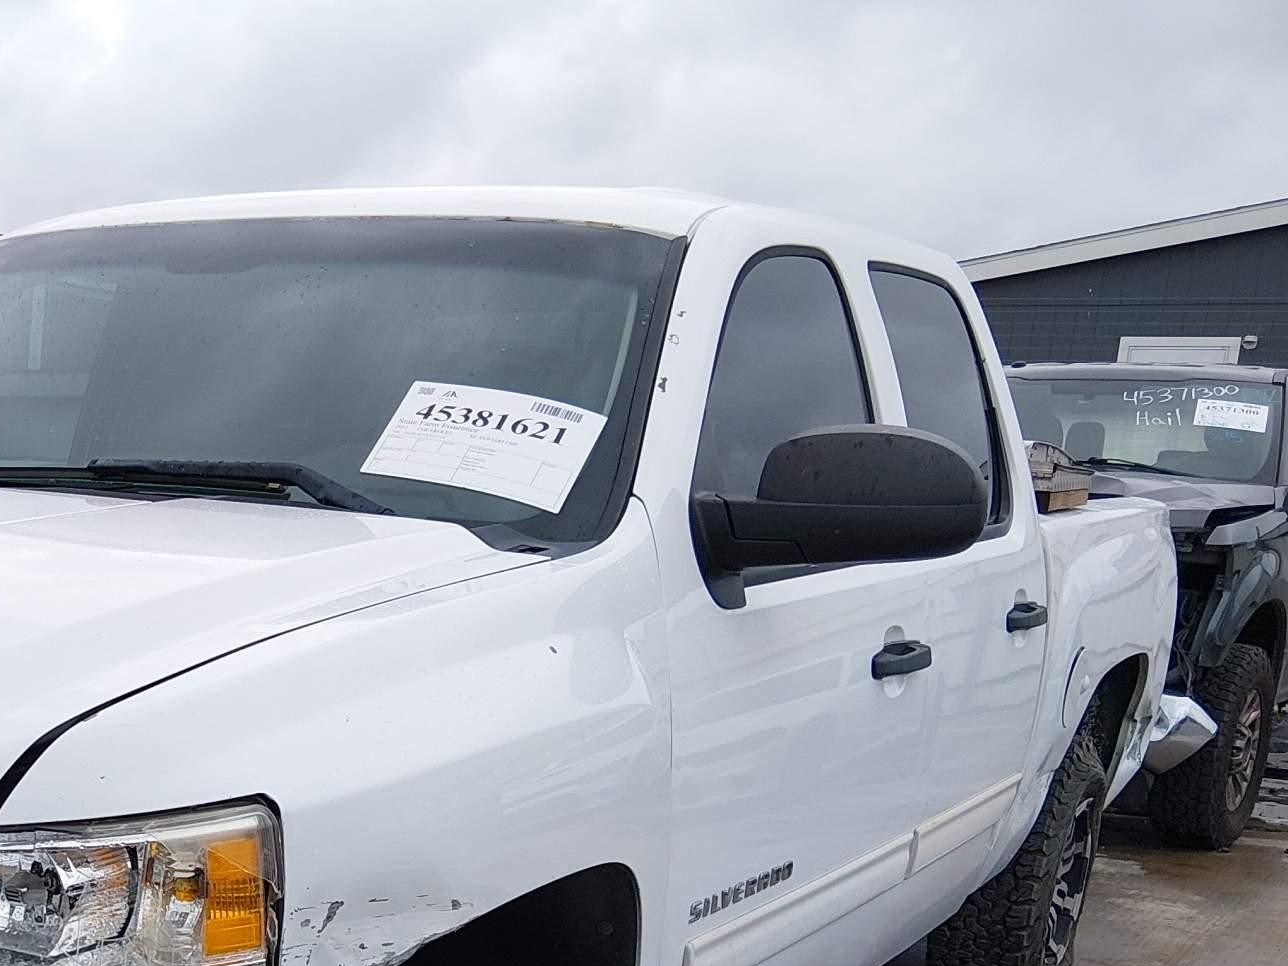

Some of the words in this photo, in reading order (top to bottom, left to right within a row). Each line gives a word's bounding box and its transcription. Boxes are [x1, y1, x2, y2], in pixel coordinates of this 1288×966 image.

[1123, 384, 1239, 406] 45371300
[415, 403, 568, 446] 45381621
[1135, 408, 1182, 427] Hail
[688, 860, 794, 925] SILVERADO
